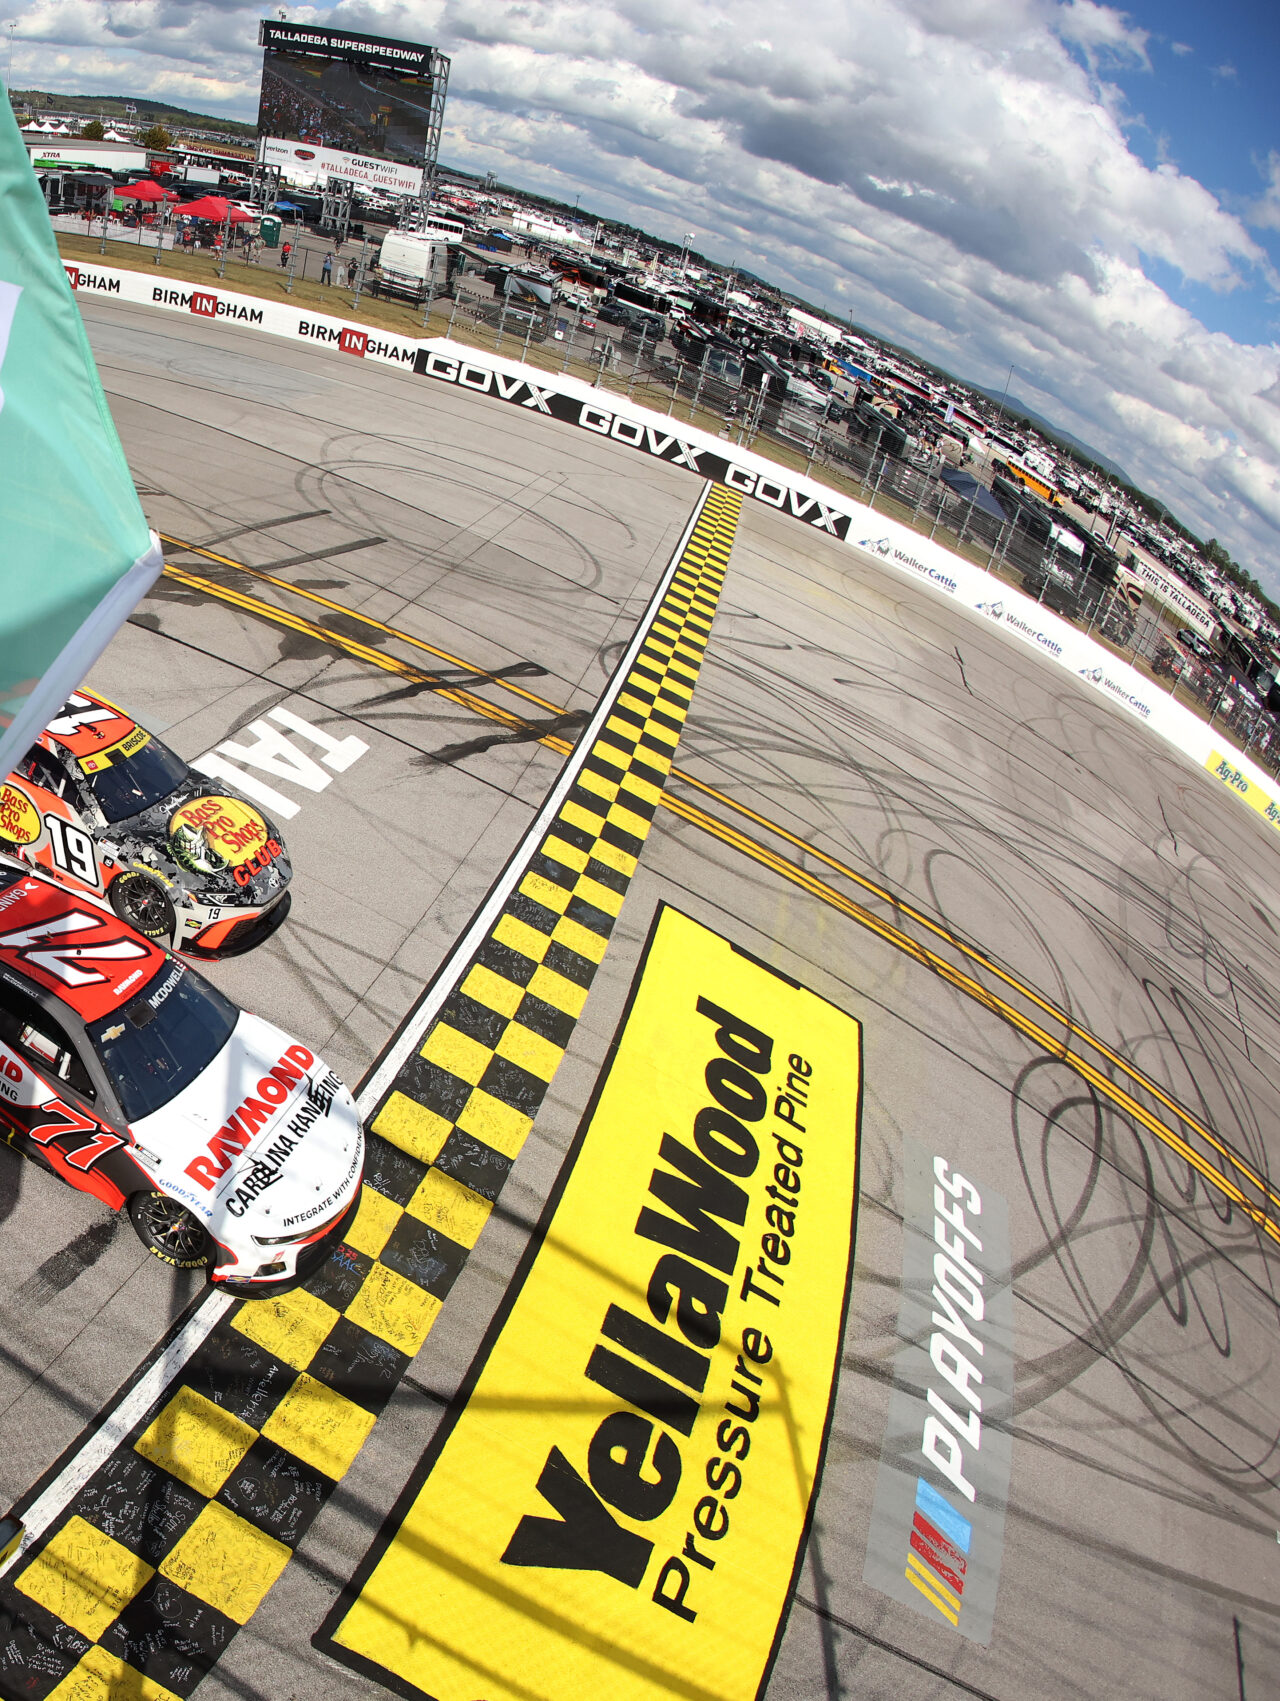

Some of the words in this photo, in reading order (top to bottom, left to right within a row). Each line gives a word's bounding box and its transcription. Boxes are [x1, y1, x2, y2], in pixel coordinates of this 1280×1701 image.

[269, 29, 328, 47] TALLADEGA
[330, 38, 425, 63] SUPERSPEEDWAY
[41, 151, 61, 159] XTRA
[320, 161, 416, 191] #TALLADEGA_GUESTWIFI
[351, 158, 398, 175] GUESTWIFI
[152, 286, 264, 325] BIRMINGHAM
[298, 320, 417, 366] BIRMINGHAM
[425, 352, 553, 415] GOVX
[578, 403, 701, 473] GOVX
[723, 462, 839, 537] GOVX
[1140, 567, 1158, 586] THIS
[1159, 582, 1169, 594] IS
[1169, 589, 1211, 629] TALLADEGA
[122, 730, 147, 752] BRISCOE
[1215, 760, 1248, 793] Ag-Pro
[0, 802, 20, 823] Pro
[1, 788, 29, 814] Bass
[179, 799, 223, 828] Bass
[202, 815, 236, 840] Pro
[221, 818, 264, 854] Shops
[44, 813, 100, 887] 19
[232, 837, 283, 887] CLUB
[207, 908, 222, 920] 19
[112, 969, 144, 997] RAYMOND
[147, 965, 187, 1010] MCDOWELL
[29, 1096, 129, 1173] 71
[183, 1043, 314, 1192] RAYMOND
[225, 1125, 302, 1219] CAROLINA
[282, 1197, 333, 1228] INTEGRATE
[331, 1179, 350, 1202] WITH
[347, 1121, 364, 1180] CONFIDENCE
[158, 1178, 214, 1218] GOODYEAR
[499, 994, 775, 1590] YellaWood
[651, 1324, 774, 1624] Pressure
[738, 1131, 808, 1308] Treated
[774, 1051, 814, 1132] Pine
[921, 1156, 984, 1503] PLAYOFFS
